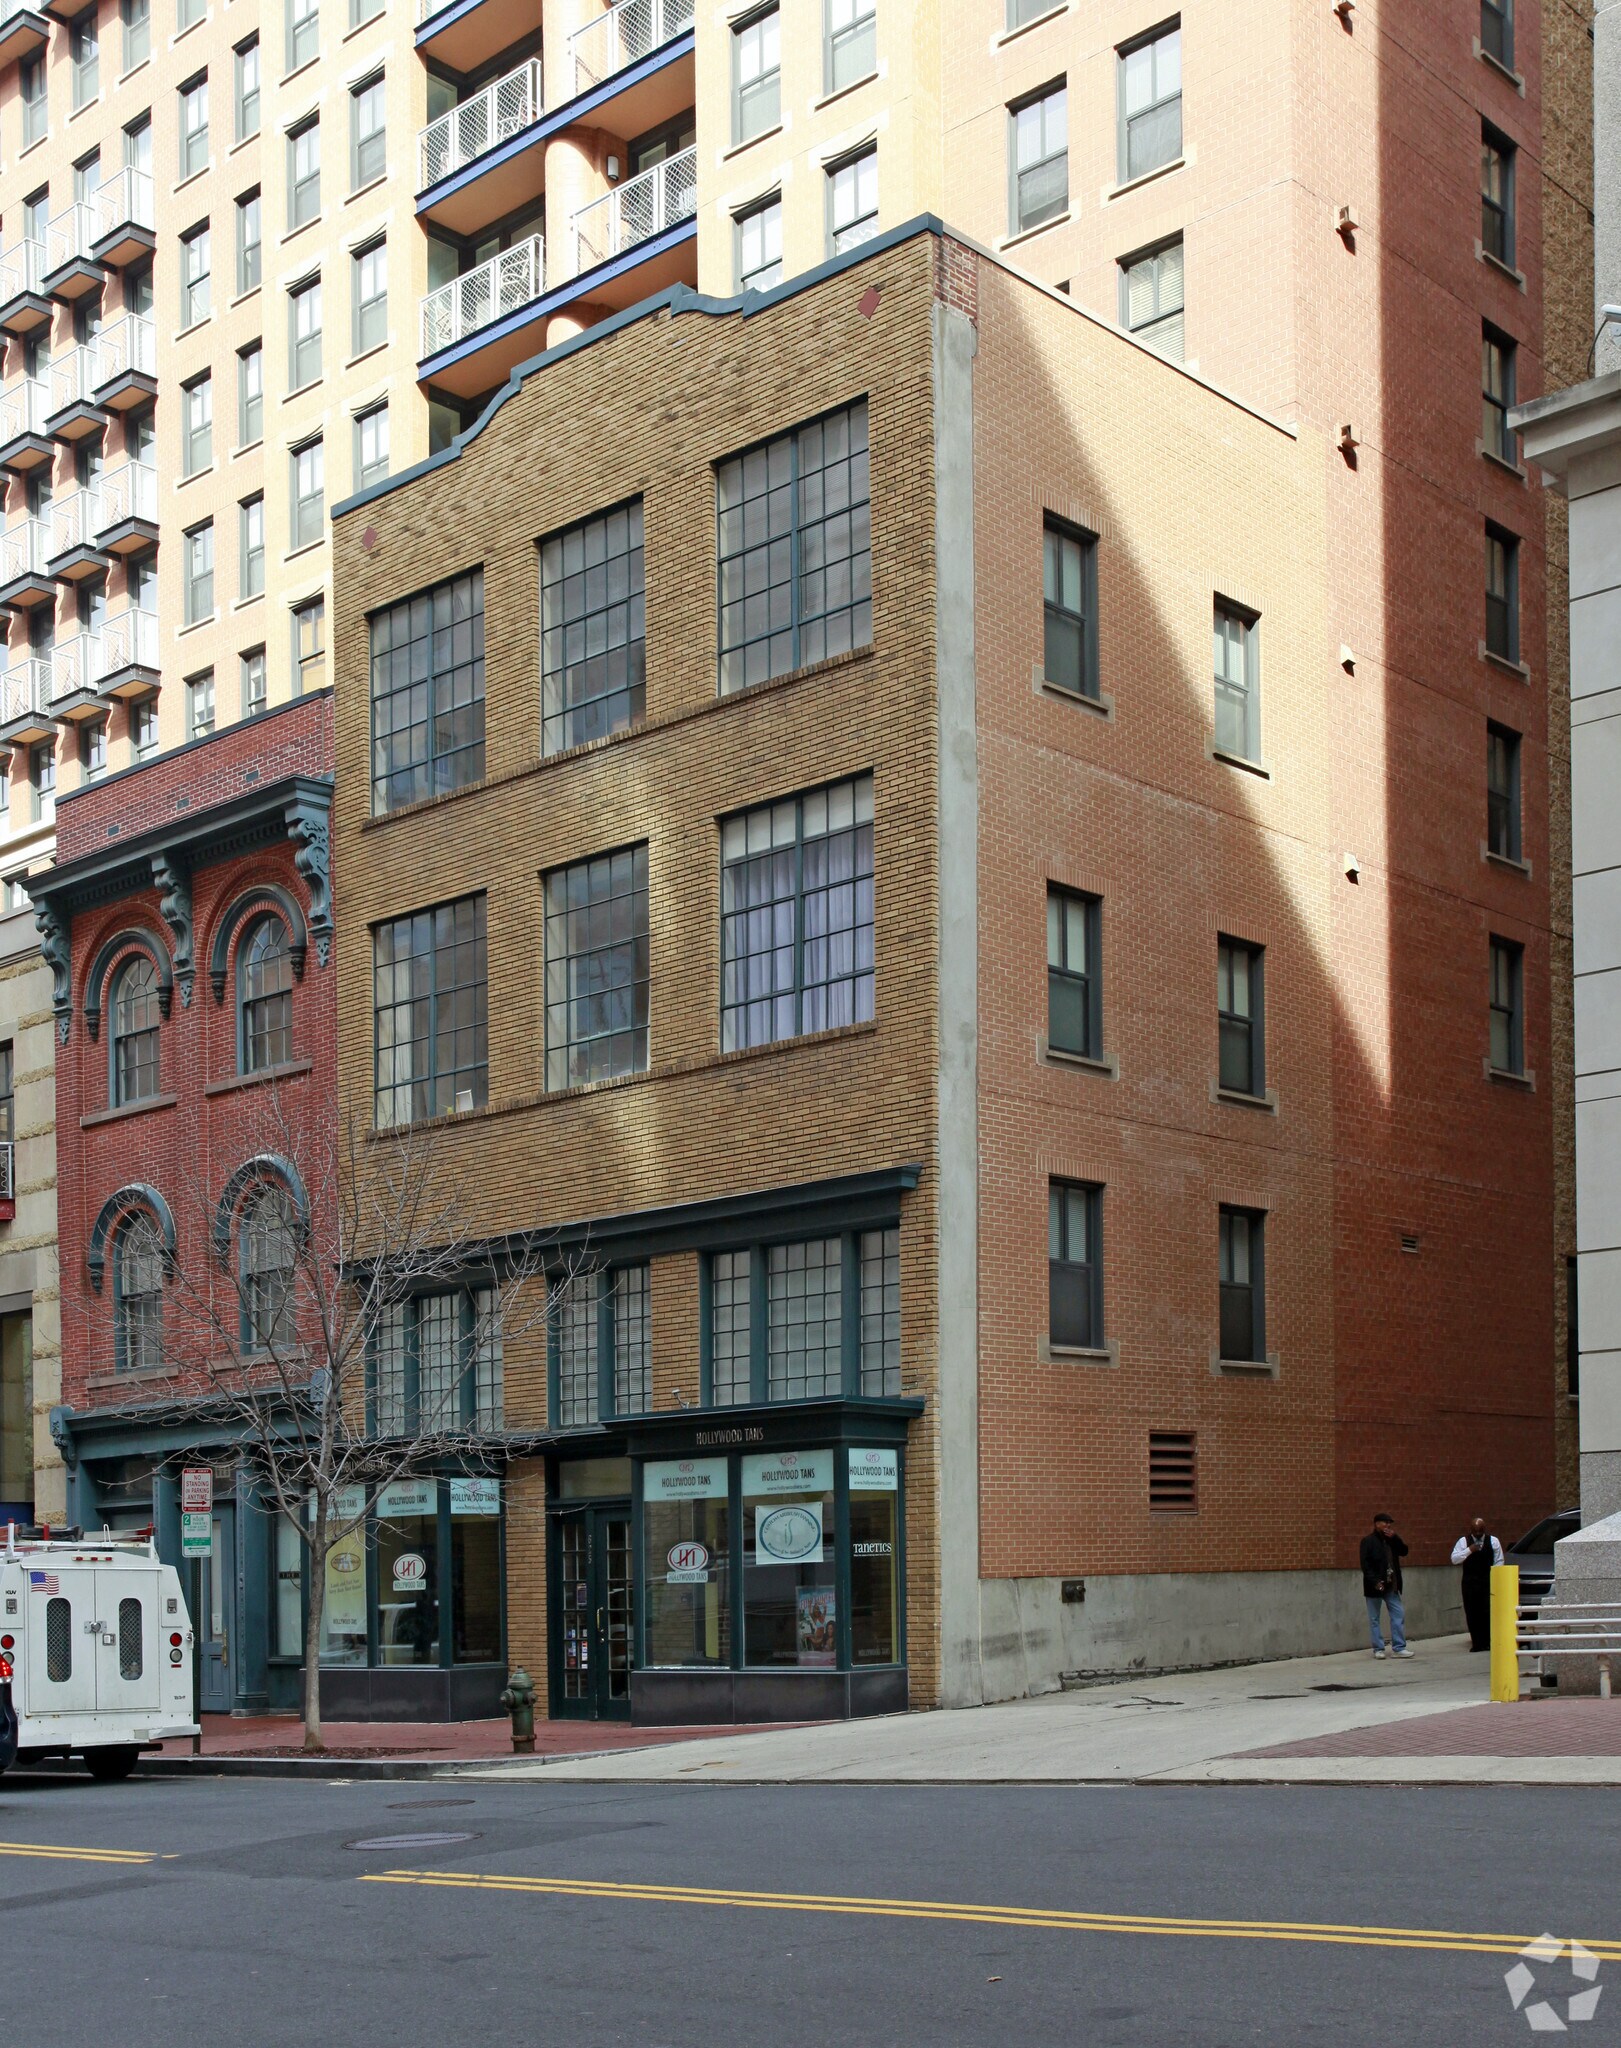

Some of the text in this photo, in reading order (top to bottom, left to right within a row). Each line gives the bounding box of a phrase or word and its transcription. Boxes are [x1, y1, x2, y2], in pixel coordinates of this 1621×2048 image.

[696, 1427, 764, 1445] HOLLYWOOD TANS
[762, 1468, 815, 1481] HOLLYWOOD TANS
[850, 1466, 896, 1476] HOLLYWOOD TANS
[662, 1475, 711, 1487] HOLLYWOOD TANS
[388, 1494, 427, 1505] HOLLYWOOD TANS
[184, 1515, 190, 1524] 2
[668, 1572, 706, 1581] HOLLYWOOD TANS
